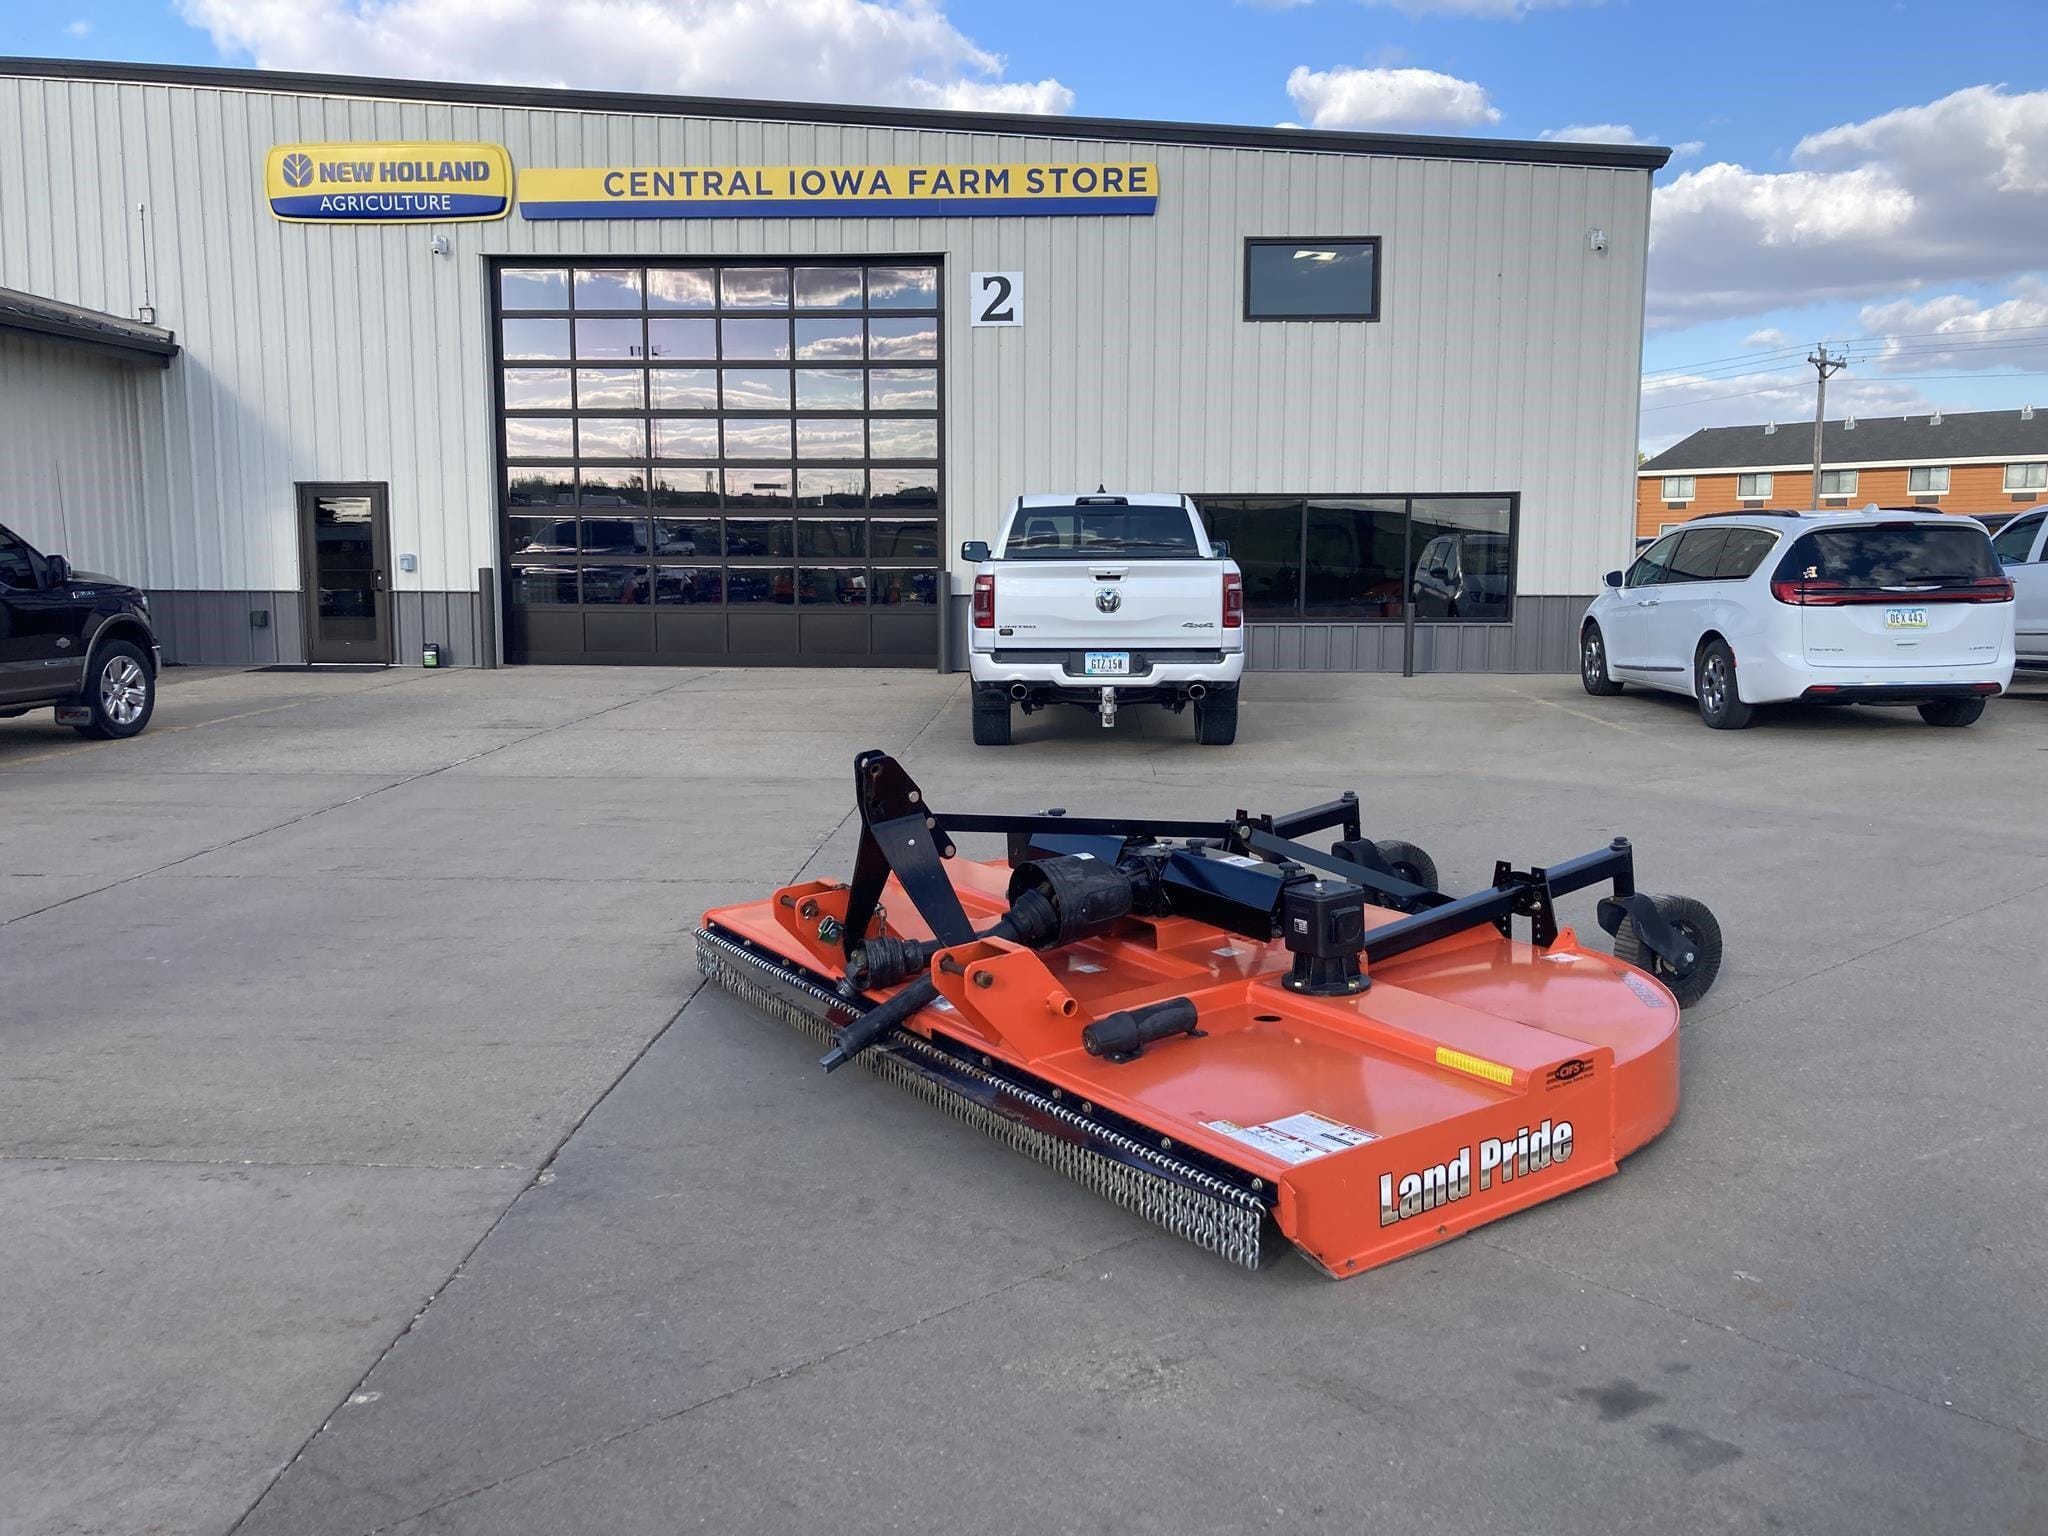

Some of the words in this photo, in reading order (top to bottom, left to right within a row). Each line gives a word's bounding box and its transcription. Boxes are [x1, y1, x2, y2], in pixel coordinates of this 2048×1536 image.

[319, 161, 375, 183] NEW
[379, 160, 490, 183] HOLLAND
[603, 170, 773, 197] CENTRAL
[789, 169, 893, 196] IOWA
[908, 168, 1009, 195] FARM
[1026, 166, 1147, 193] STORE
[320, 194, 451, 212] AGRICULTURE
[980, 276, 1014, 321] 2
[1908, 613, 1923, 624] 443
[1091, 658, 1106, 670] GTZ
[1108, 658, 1123, 670] 150
[1379, 1145, 1472, 1228] Land
[1479, 1118, 1574, 1192] Pride
